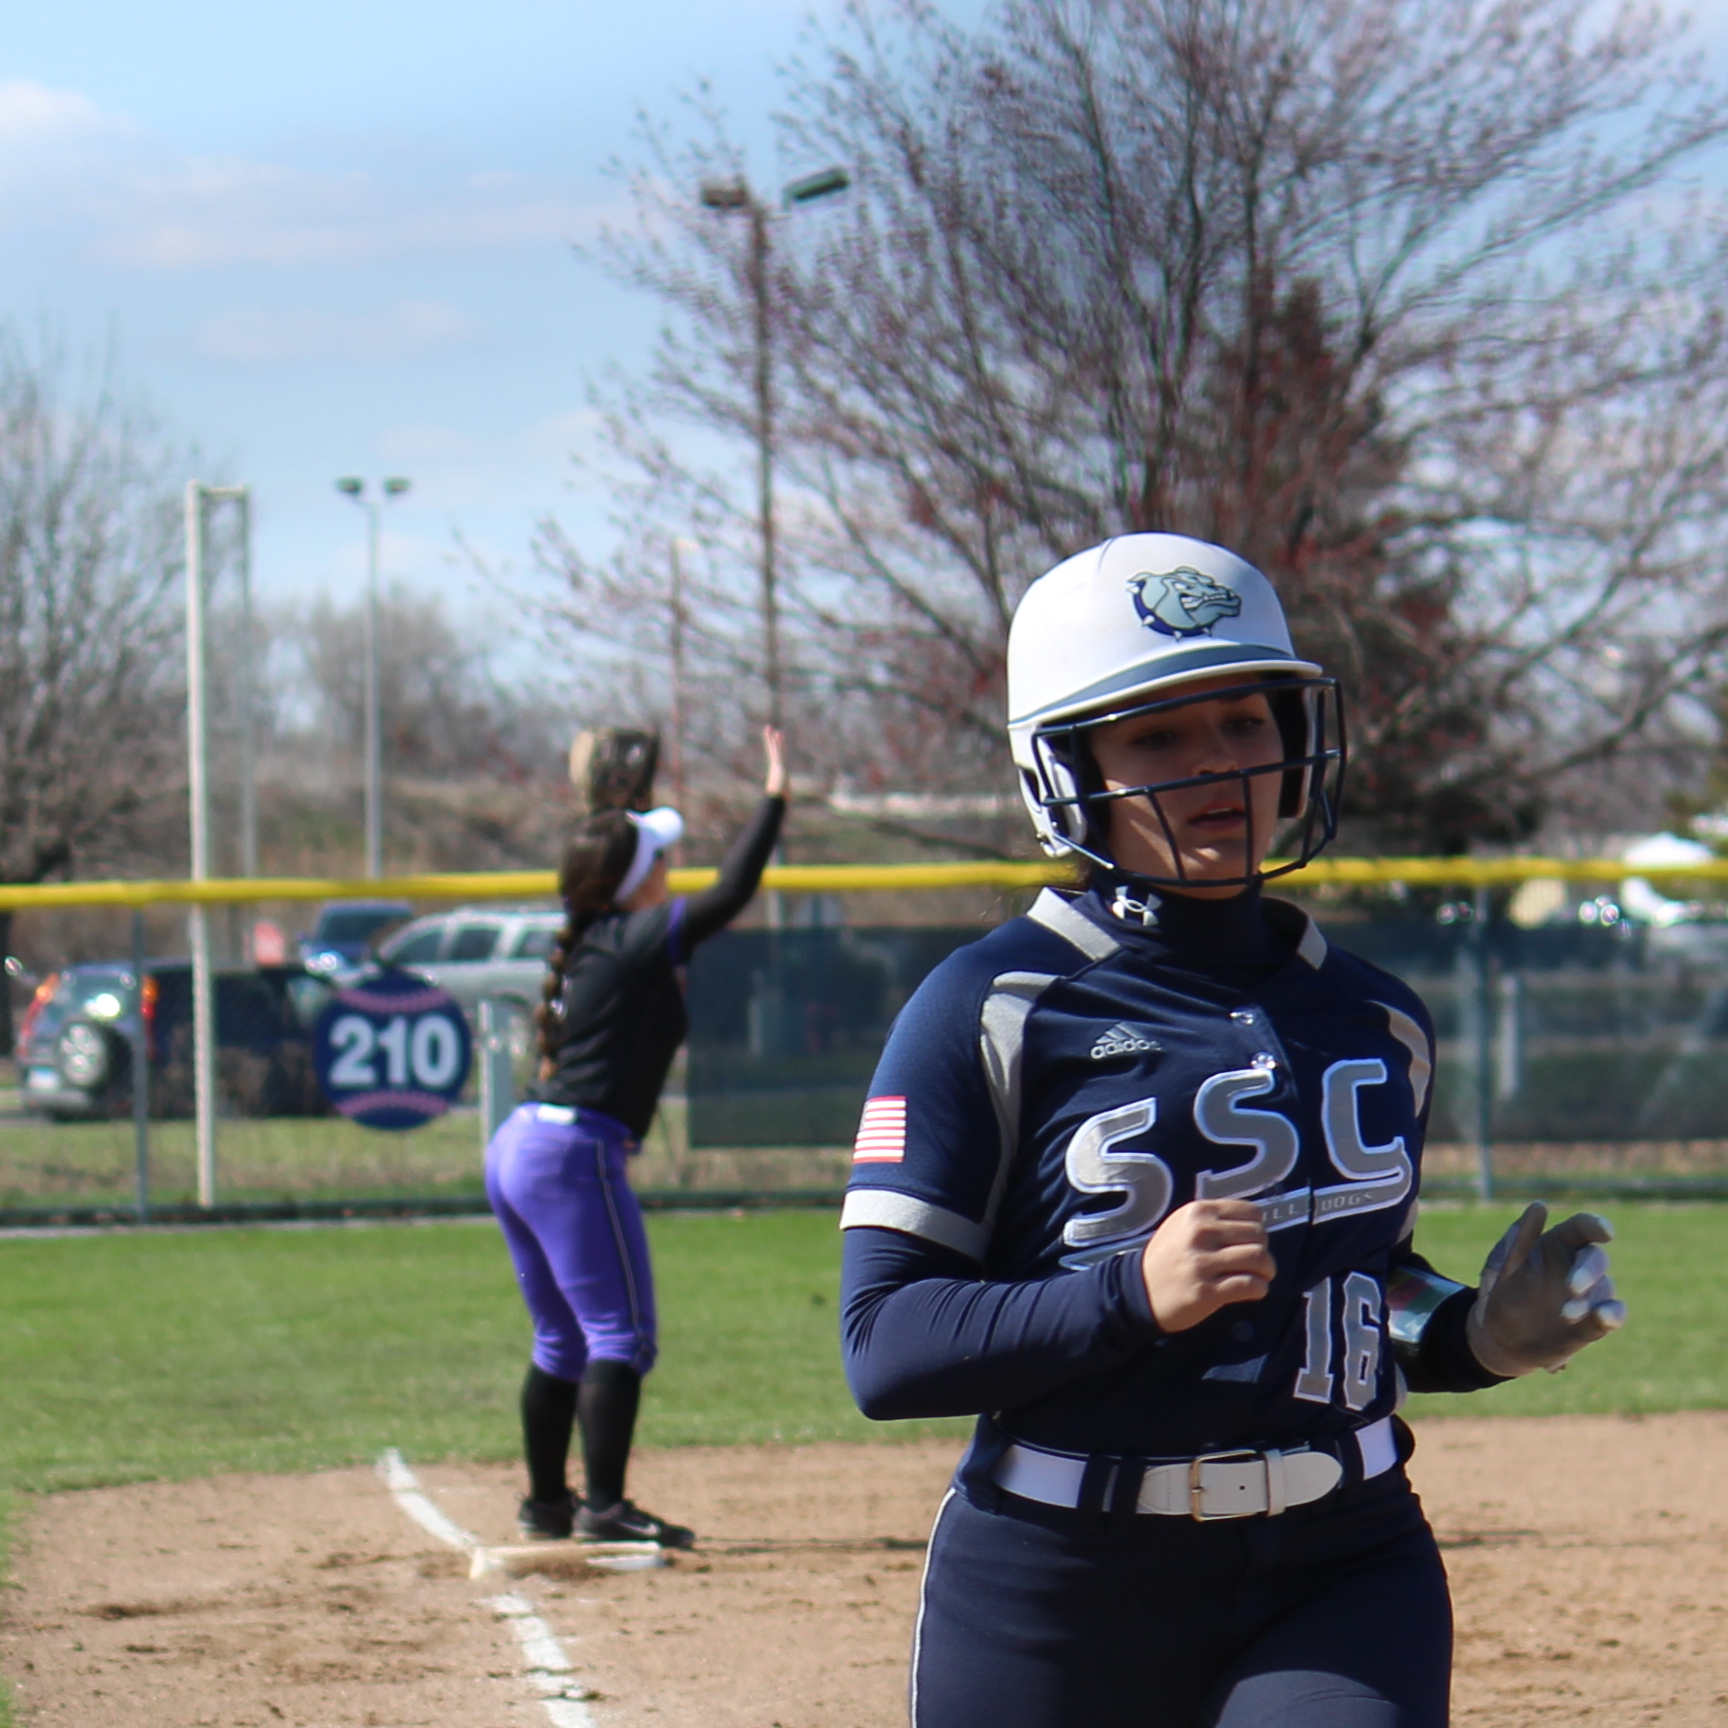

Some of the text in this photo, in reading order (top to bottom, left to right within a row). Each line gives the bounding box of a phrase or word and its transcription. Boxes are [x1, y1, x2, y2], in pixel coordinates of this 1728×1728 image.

[329, 1012, 459, 1087] 210
[1063, 1057, 1412, 1248] SSC
[1293, 1271, 1382, 1411] 16
